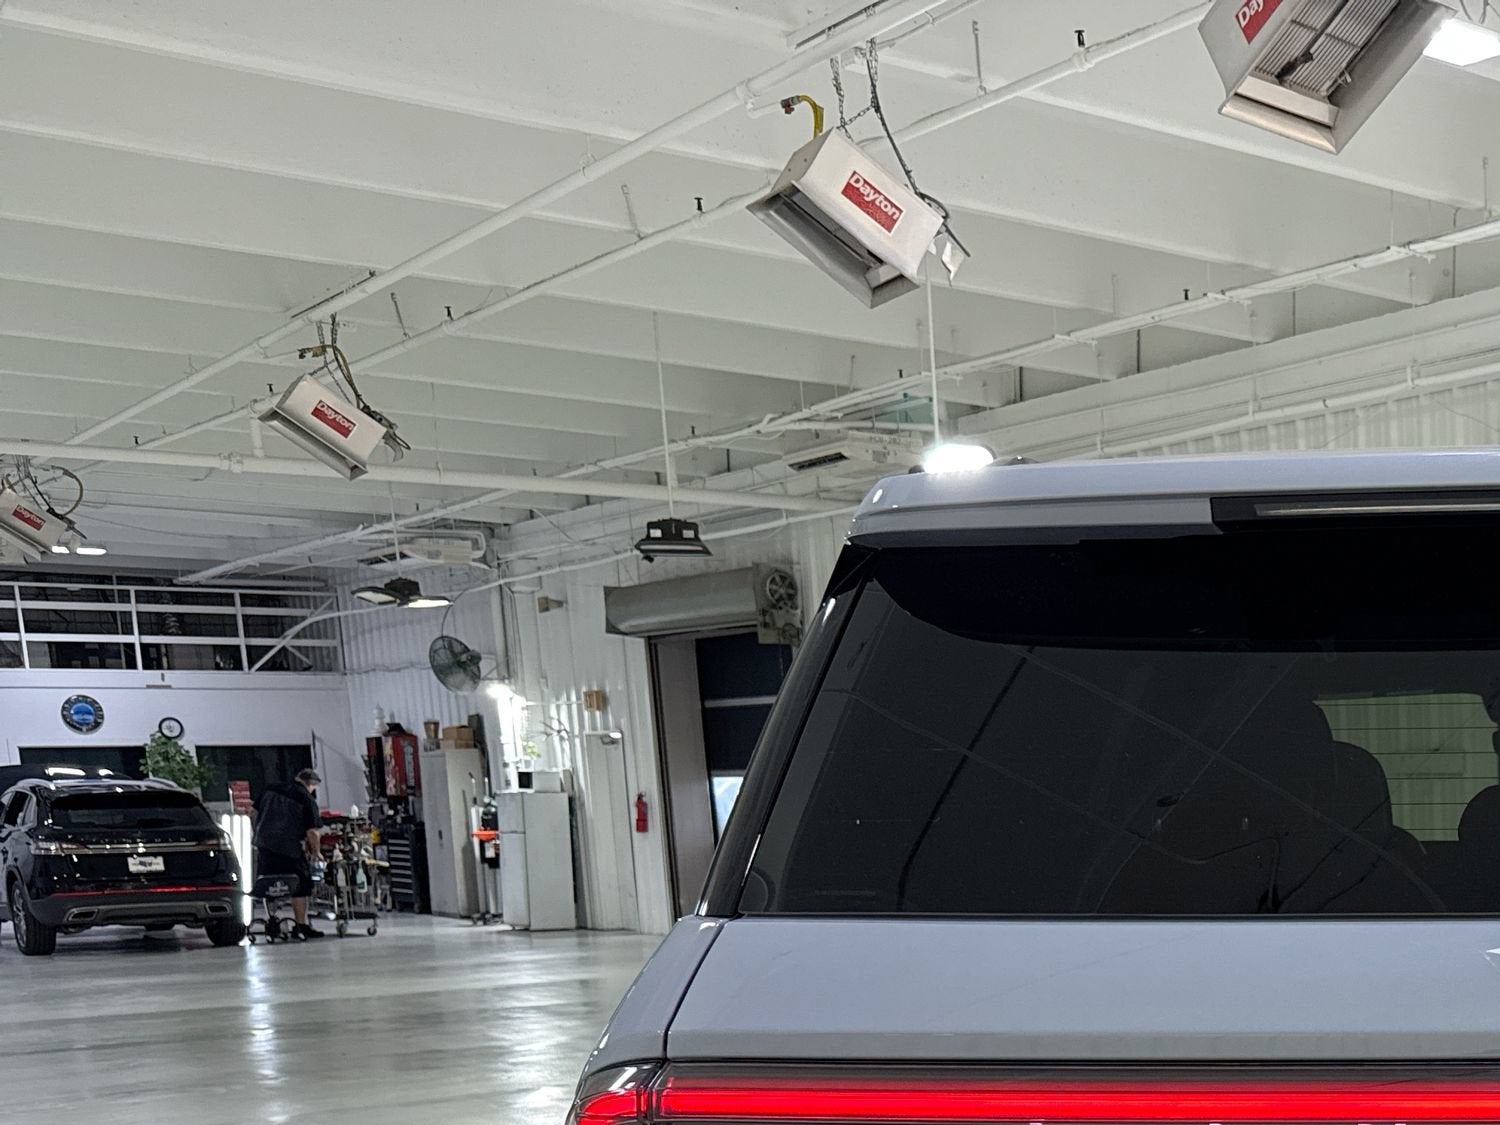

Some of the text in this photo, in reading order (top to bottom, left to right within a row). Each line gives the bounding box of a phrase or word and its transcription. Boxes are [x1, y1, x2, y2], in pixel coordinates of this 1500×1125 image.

[848, 173, 900, 220] Dayton
[316, 401, 354, 430] Dayton
[16, 505, 45, 527] Dayton
